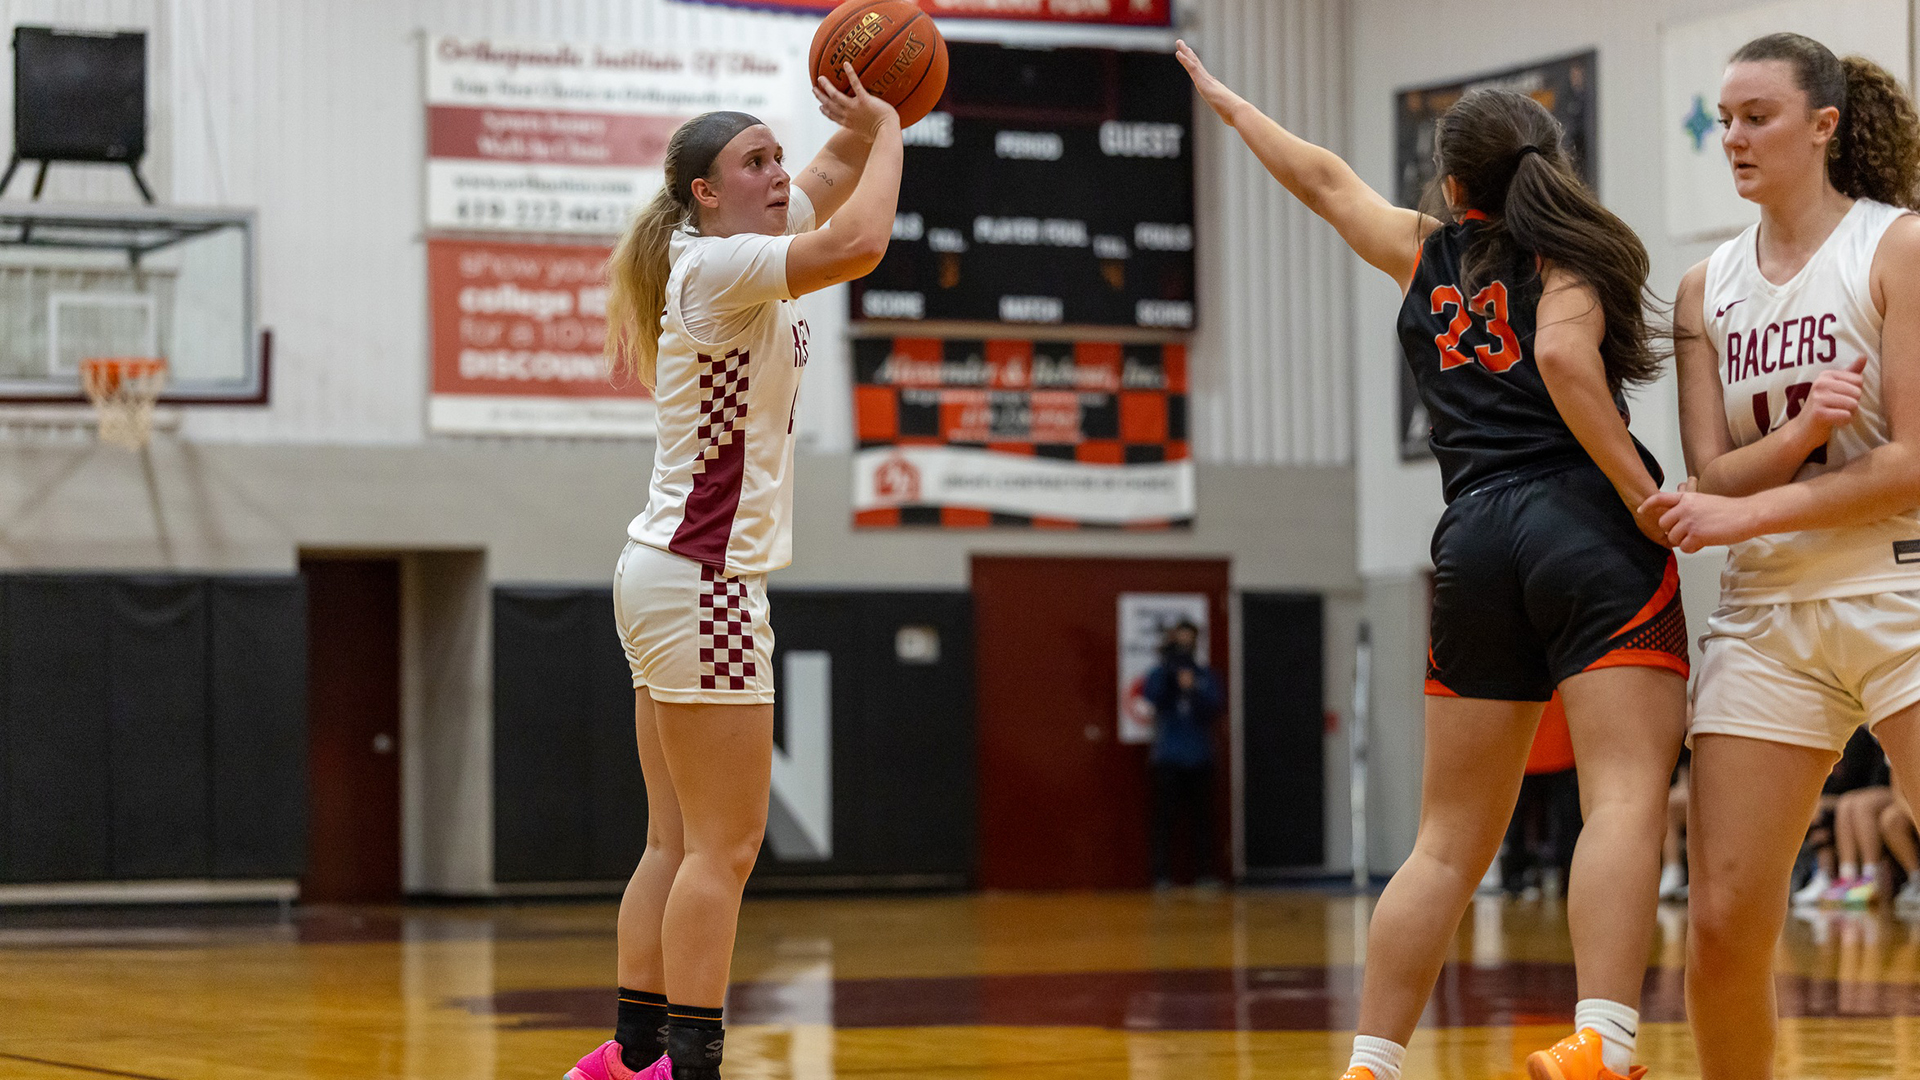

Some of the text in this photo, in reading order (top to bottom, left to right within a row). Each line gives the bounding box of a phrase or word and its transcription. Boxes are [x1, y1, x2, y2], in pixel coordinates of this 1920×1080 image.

[591, 47, 686, 73] Institute
[726, 51, 782, 76] Ohio
[834, 14, 896, 82] LEGACY
[868, 30, 926, 97] SPALDIN
[996, 132, 1062, 160] PERIOD
[1100, 121, 1182, 157] GUEST
[975, 216, 1088, 246] PLAYER FOUL
[1136, 223, 1192, 250] FOULS
[546, 256, 610, 283] you
[460, 285, 573, 318] college
[864, 292, 924, 318] SCORE
[1136, 301, 1193, 327] SCORE
[1430, 280, 1523, 374] 23
[1727, 312, 1838, 386] RACERS
[460, 350, 607, 380] DISCOUN
